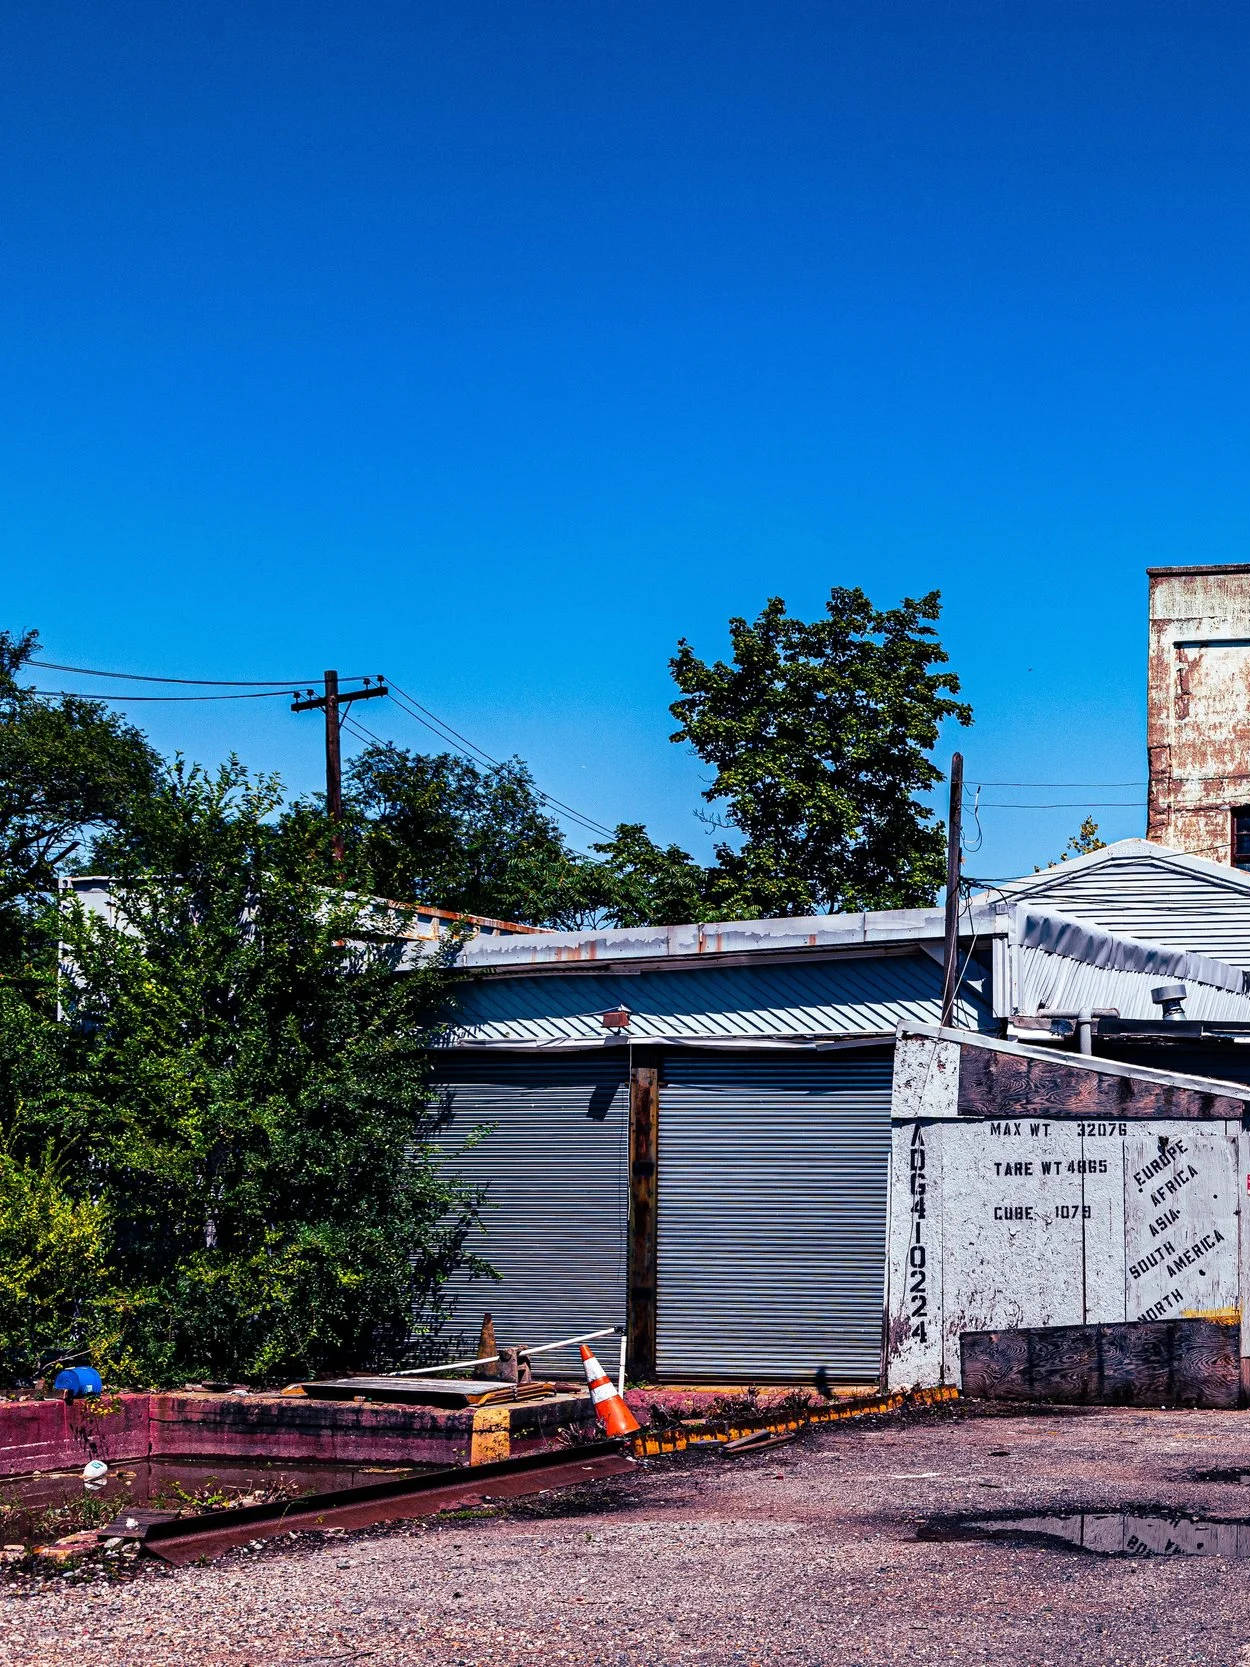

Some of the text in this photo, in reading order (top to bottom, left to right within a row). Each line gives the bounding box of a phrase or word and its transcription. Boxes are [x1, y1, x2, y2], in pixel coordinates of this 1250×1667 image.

[990, 1122, 1127, 1137] MAX WT 32076
[994, 1161, 1033, 1176] TARE
[1041, 1161, 1062, 1175] WT
[1133, 1139, 1189, 1186] EUROPE
[1150, 1164, 1199, 1208] AFRICA
[994, 1206, 1034, 1220] CUBE
[1148, 1208, 1180, 1237] ASIA
[1128, 1240, 1176, 1280] SOUTH
[1166, 1229, 1225, 1278] AMERICA
